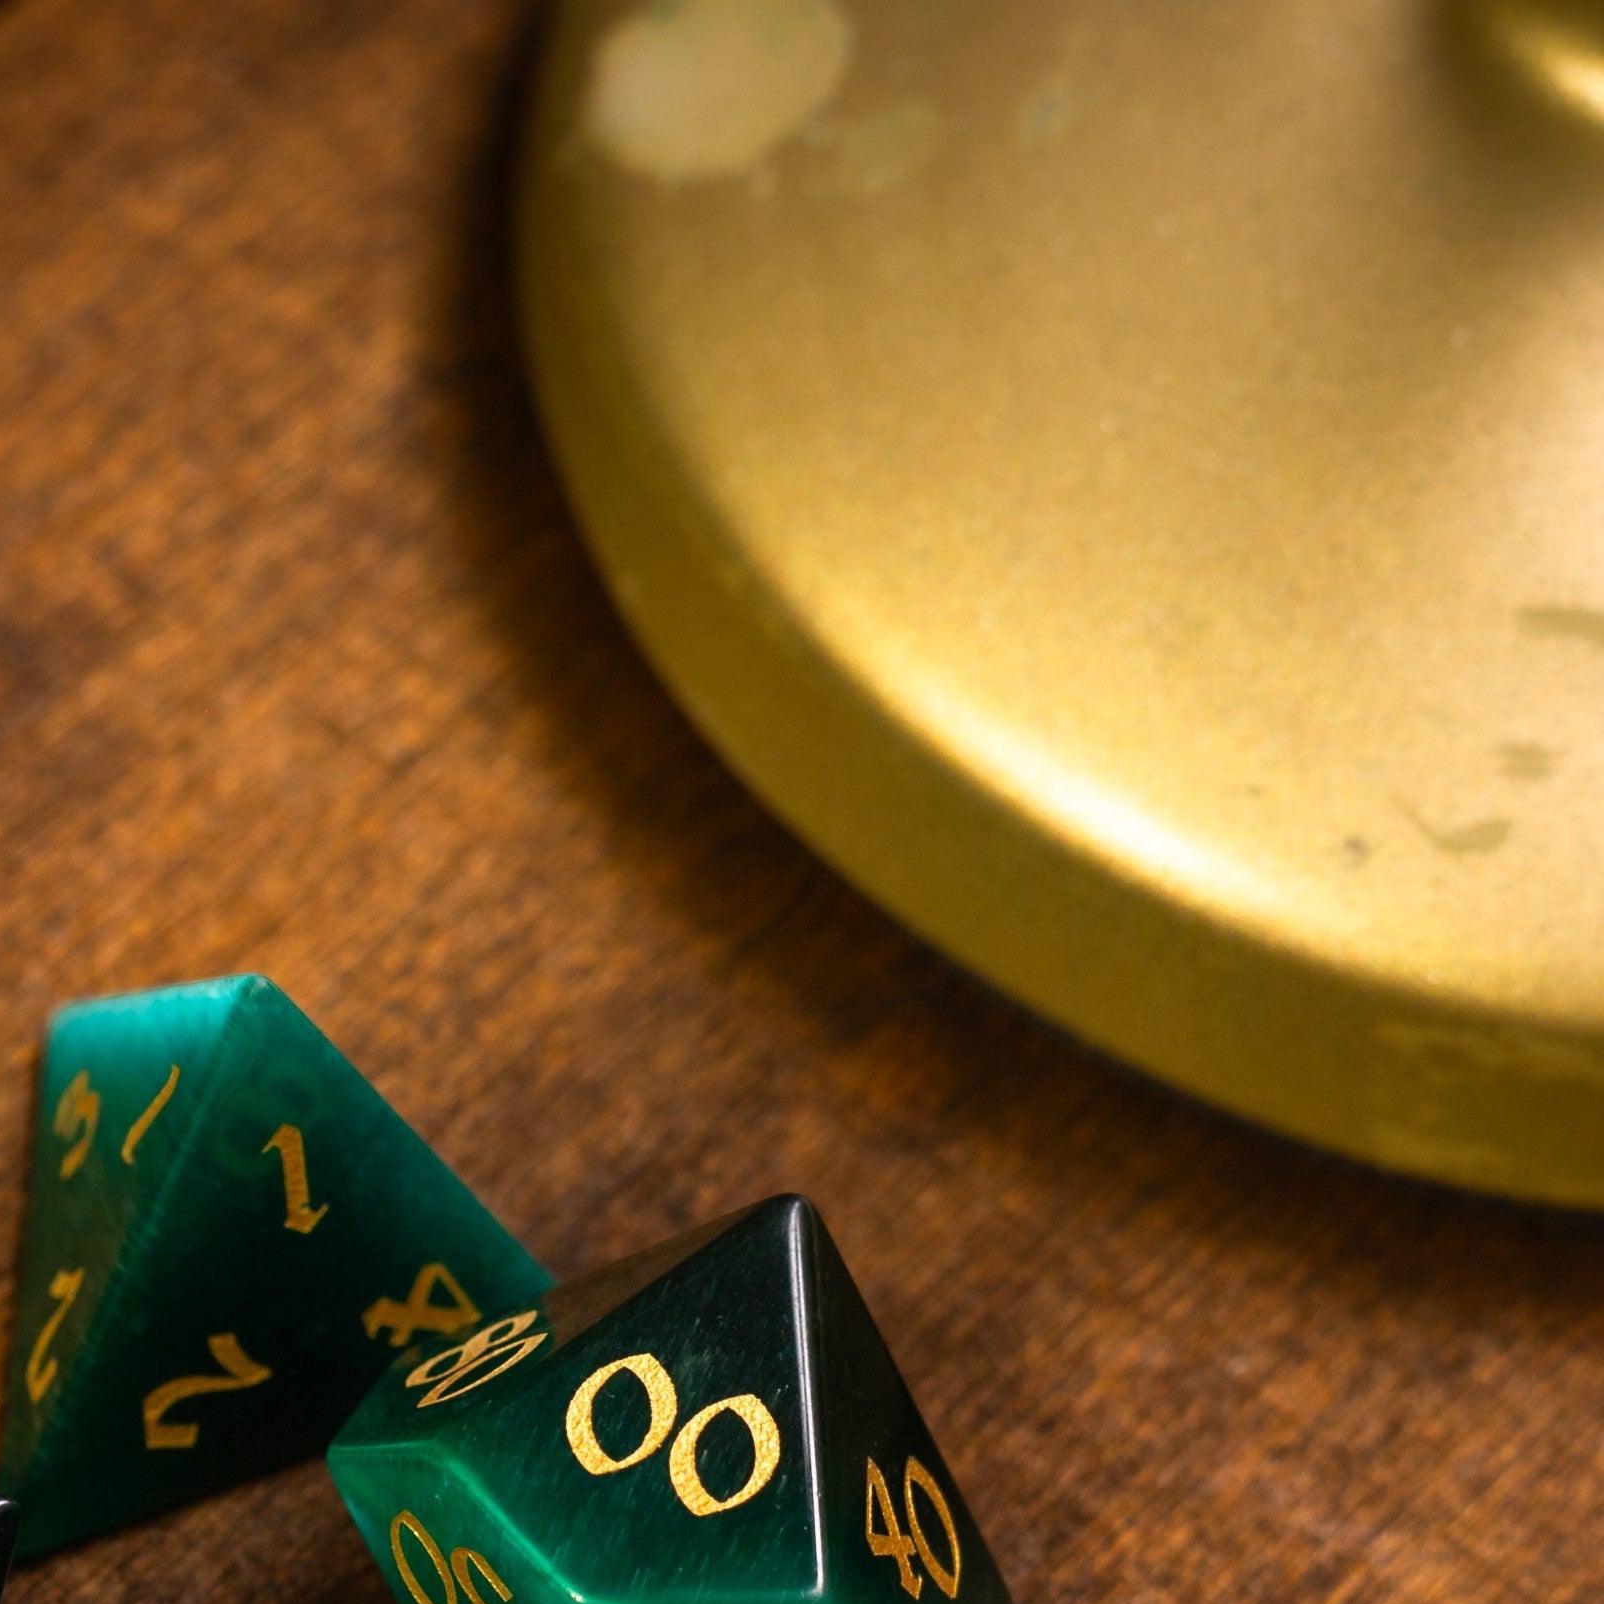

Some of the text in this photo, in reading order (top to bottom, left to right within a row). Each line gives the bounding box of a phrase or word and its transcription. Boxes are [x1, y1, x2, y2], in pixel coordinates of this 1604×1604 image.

[262, 1124, 329, 1235] 1
[362, 1262, 482, 1347] 4
[565, 1352, 782, 1517] 00
[865, 1455, 962, 1600] 40
